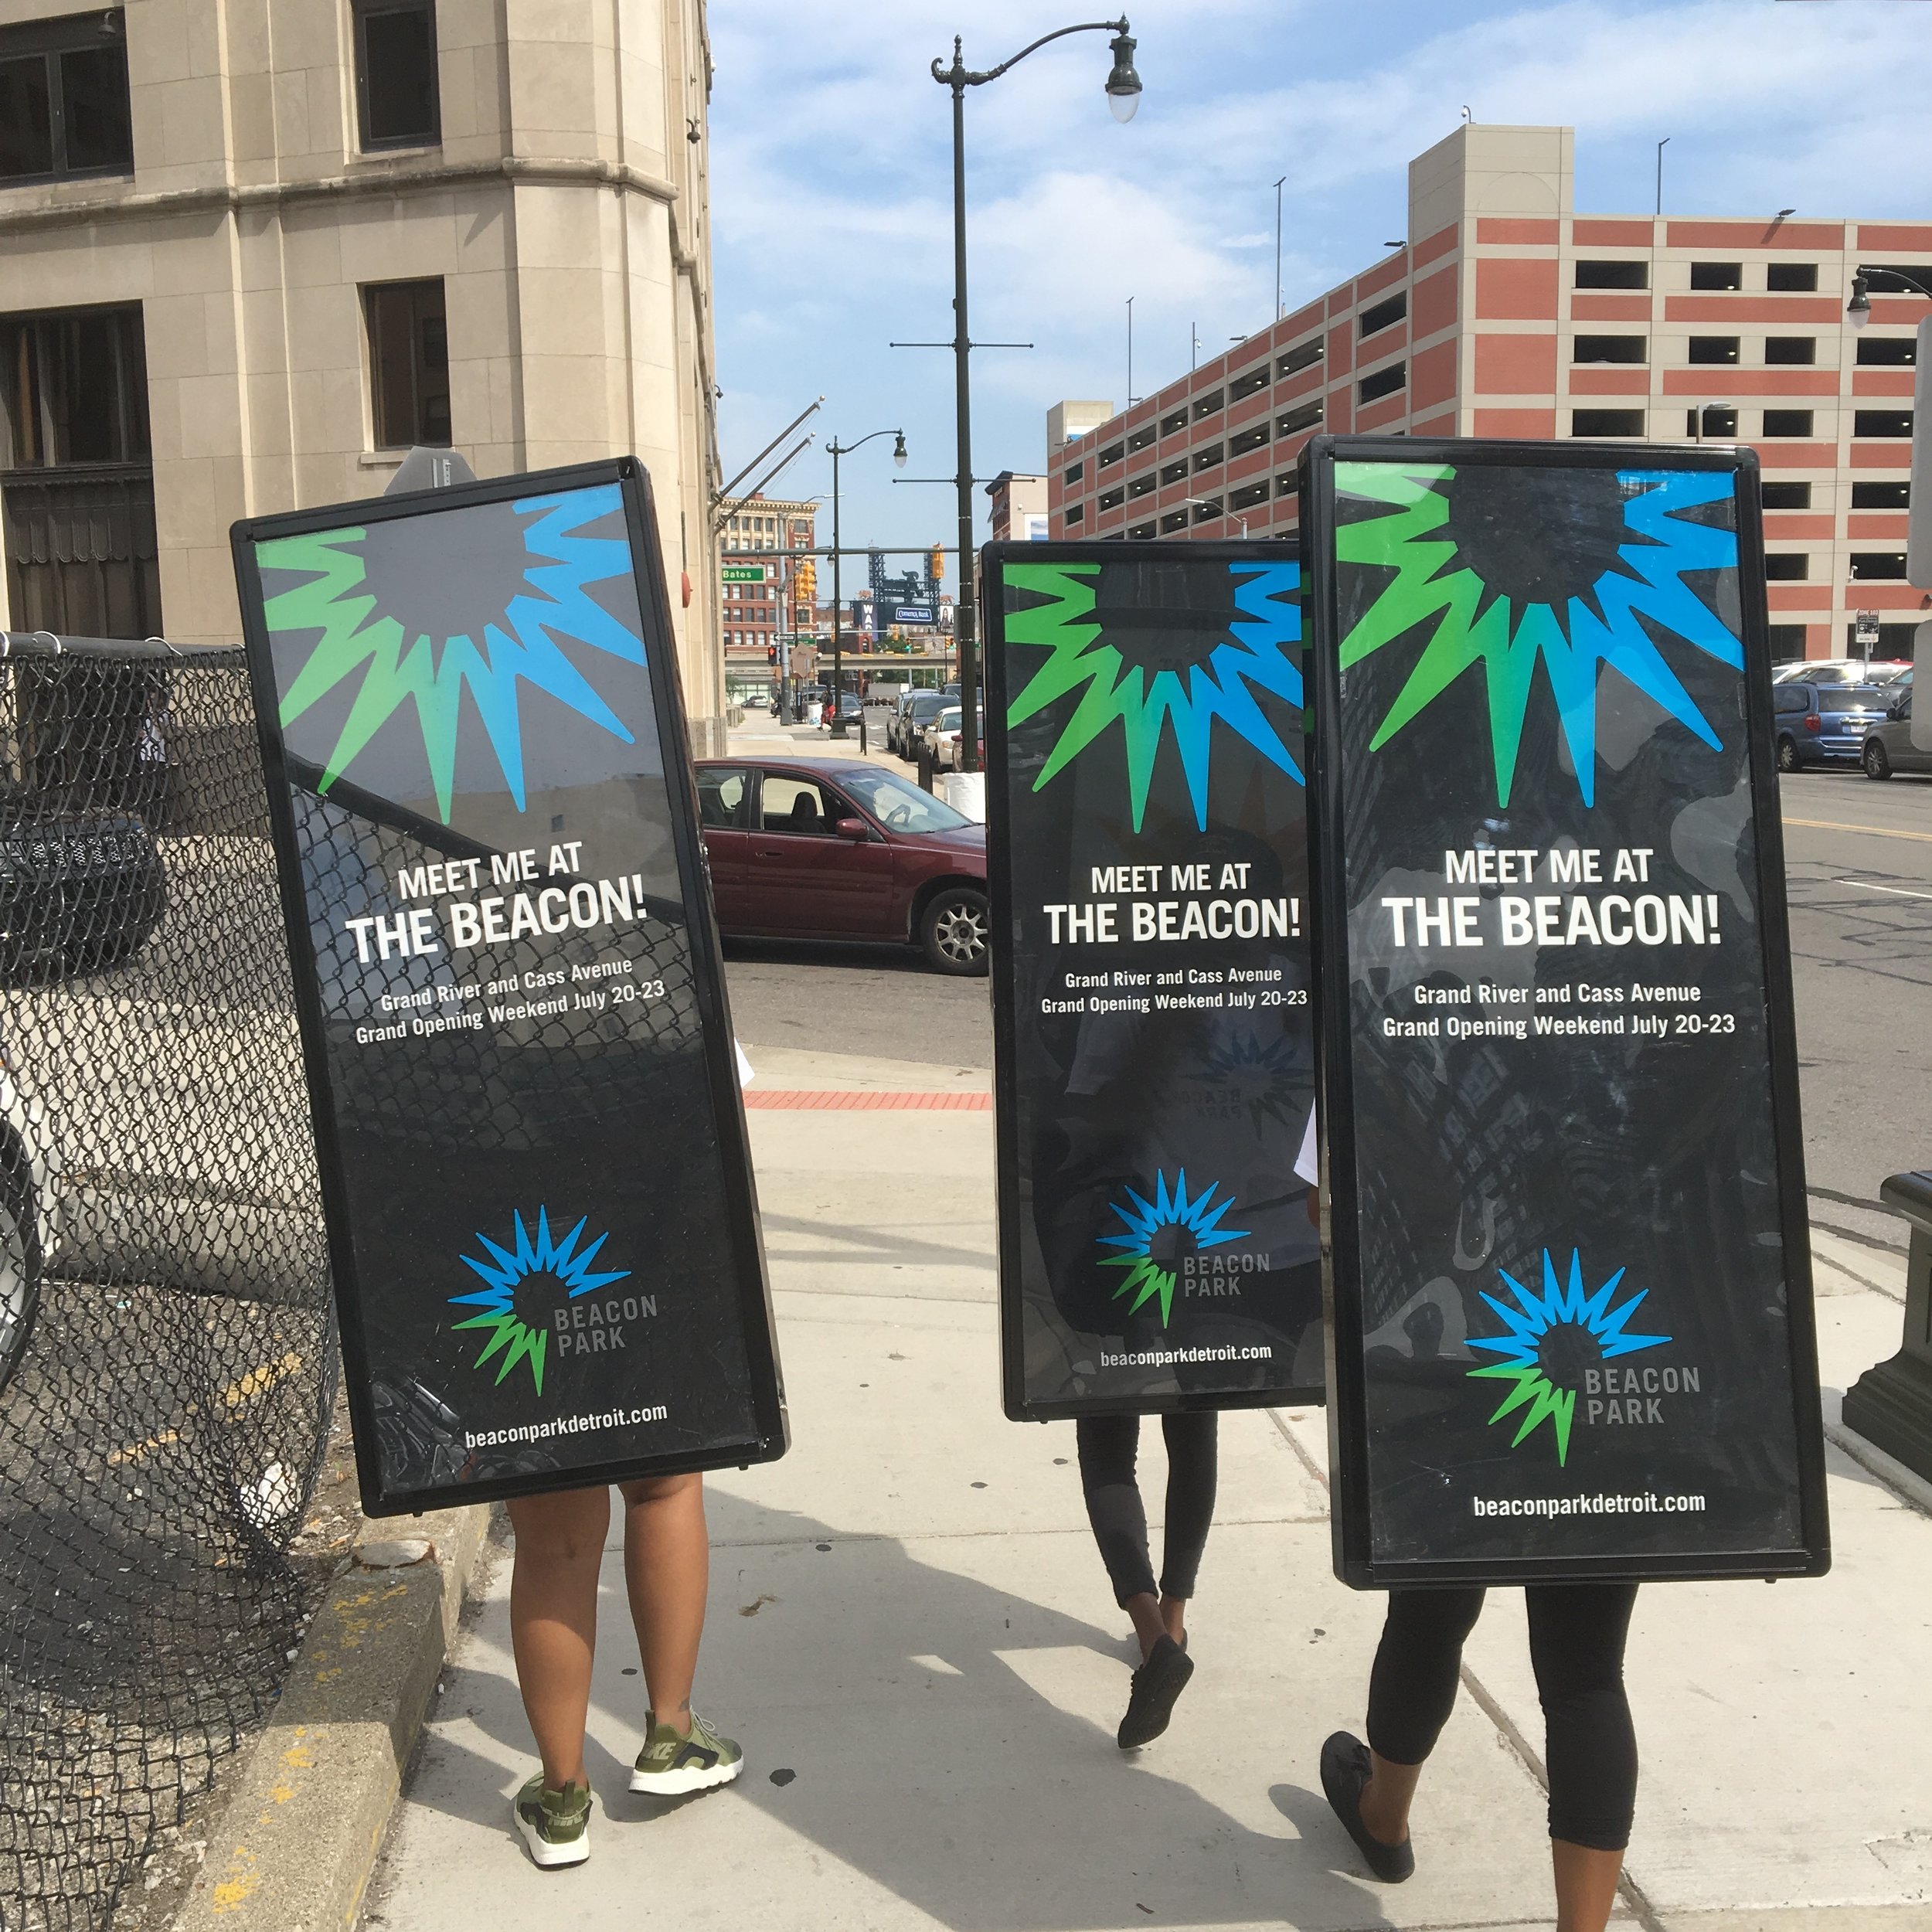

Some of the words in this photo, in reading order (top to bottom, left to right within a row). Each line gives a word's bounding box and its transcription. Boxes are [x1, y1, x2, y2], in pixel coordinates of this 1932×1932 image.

[723, 570, 752, 579] Bates
[398, 857, 481, 900] MEET
[490, 849, 539, 885] ME
[549, 841, 583, 876] AT
[1091, 865, 1163, 893] MEET
[1171, 864, 1212, 891] ME
[1219, 862, 1251, 890] AT
[1445, 849, 1539, 885] MEET
[1549, 849, 1603, 883] ME
[1613, 849, 1654, 883] AT
[345, 907, 439, 964] THE
[449, 873, 648, 949] BEACON!
[1043, 903, 1119, 944] THE
[1132, 898, 1301, 941] BEACON!
[1381, 896, 1484, 947] THE
[1499, 894, 1722, 947] BEACON!
[380, 988, 432, 1012] Grand
[437, 983, 482, 1003] River
[488, 974, 519, 995] and
[524, 970, 566, 990] Cass
[571, 960, 633, 982] Avenue
[1066, 971, 1108, 988] Grand
[1114, 971, 1152, 986] River
[1156, 969, 1183, 985] and
[1189, 968, 1223, 984] Cass
[1228, 968, 1282, 983] Avenue
[1042, 997, 1085, 1014] Grand
[1090, 996, 1151, 1015] Opening
[1155, 992, 1223, 1009] Weekend
[1227, 992, 1256, 1009] July
[1260, 990, 1308, 1006] 20-23
[1414, 985, 1471, 1005] Grand
[1478, 984, 1529, 1004] River
[1536, 984, 1571, 1003] and
[1578, 983, 1624, 1003] Cass
[1631, 983, 1701, 1002] Avenue
[356, 1020, 407, 1045] Grand
[412, 1011, 484, 1038] Opening
[487, 995, 569, 1024] Weekend
[573, 988, 607, 1011] July
[611, 979, 665, 1004] 20-23
[1383, 1017, 1440, 1037] Grand
[1447, 1015, 1528, 1040] Opening
[1533, 1015, 1624, 1036] Weekend
[1631, 1015, 1668, 1039] July
[1675, 1014, 1736, 1033] 20-23
[1183, 1253, 1270, 1276] BEACON
[1185, 1277, 1242, 1298] PARK
[554, 1294, 658, 1332] BEACON
[558, 1326, 626, 1357] PARK
[1100, 1344, 1273, 1368] beaconparkdetroit.com
[1584, 1366, 1701, 1395] BEACON
[465, 1404, 668, 1449] beaconparkdetroit.com
[1587, 1398, 1665, 1425] PARK
[1474, 1492, 1706, 1520] beaconparkdetroit.com
